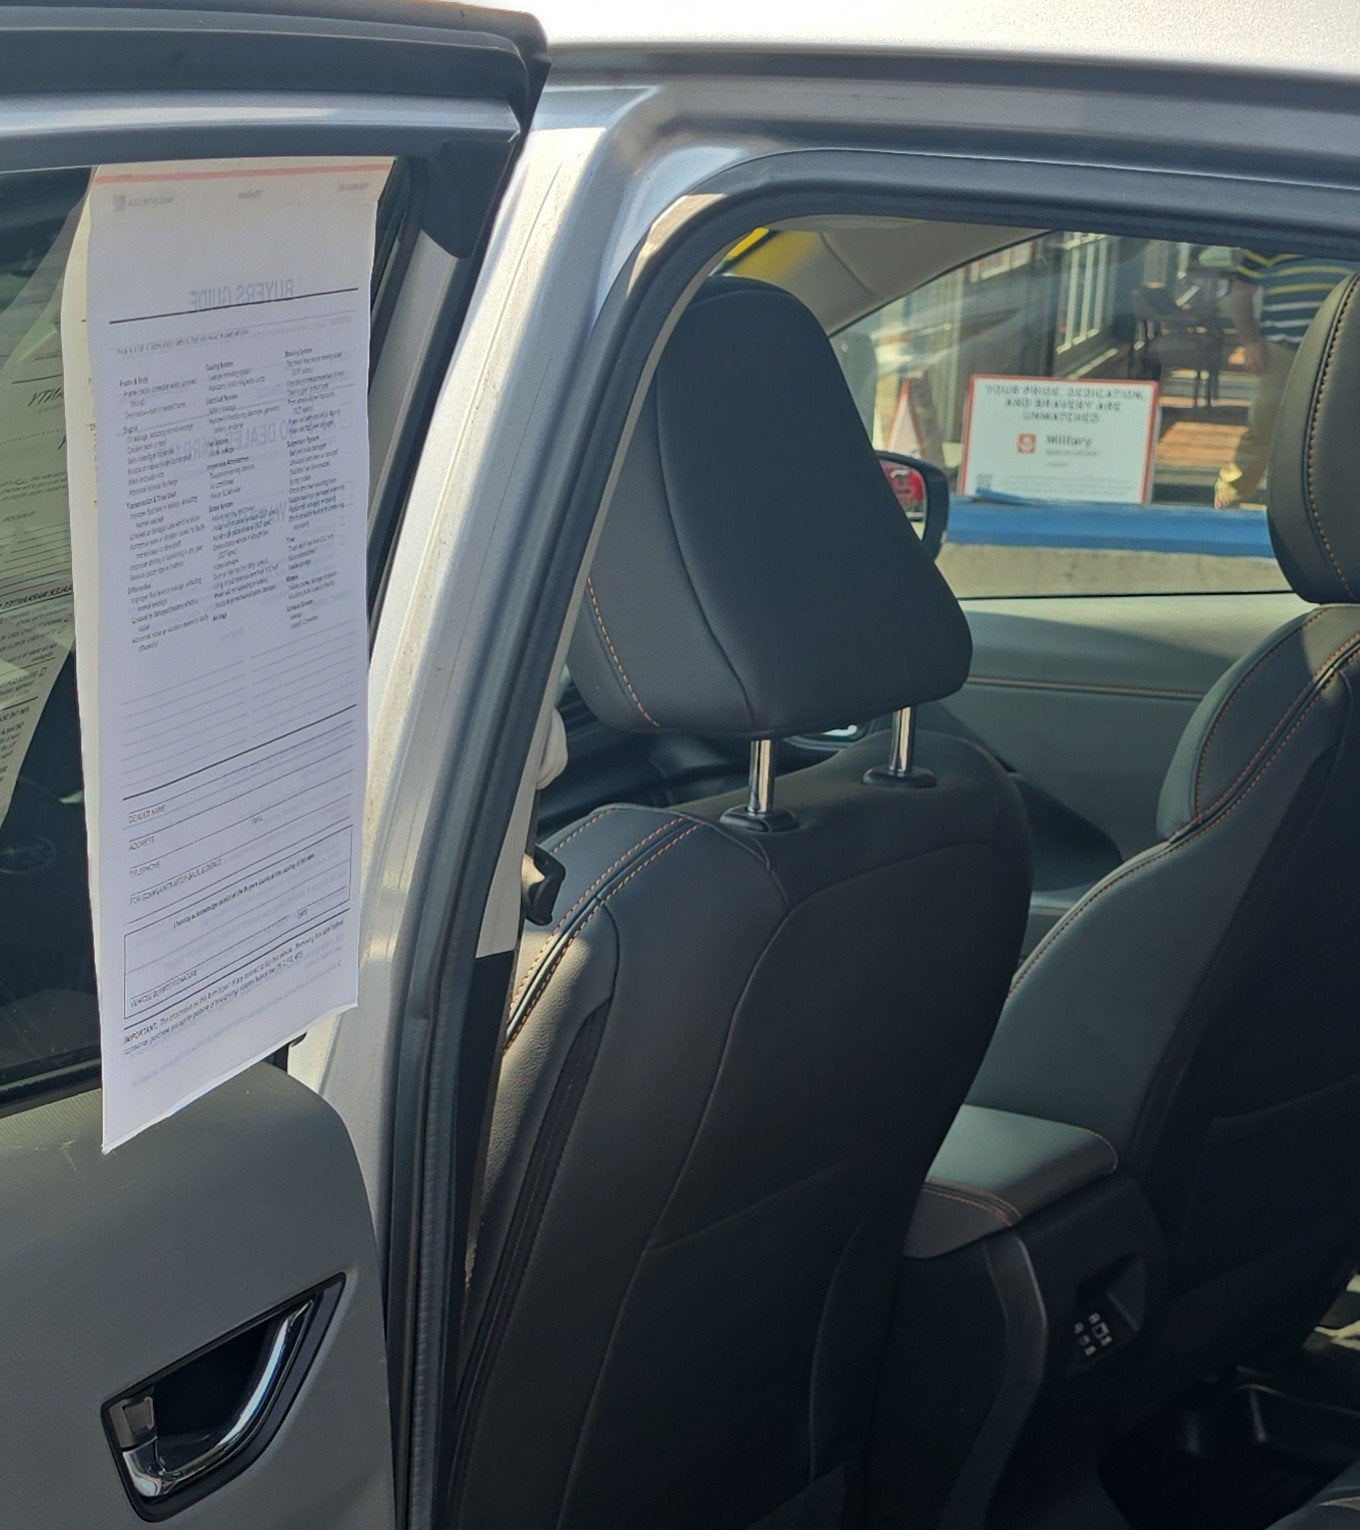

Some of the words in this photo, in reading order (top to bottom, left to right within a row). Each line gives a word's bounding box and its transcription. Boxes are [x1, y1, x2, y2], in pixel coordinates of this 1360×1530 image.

[985, 384, 1019, 395] YOUR
[1006, 397, 1029, 407] AND
[1035, 397, 1092, 409] BRAVERY
[1096, 399, 1120, 411] ARE
[1022, 410, 1100, 423] UNMATCHED
[1045, 433, 1092, 447] Military
